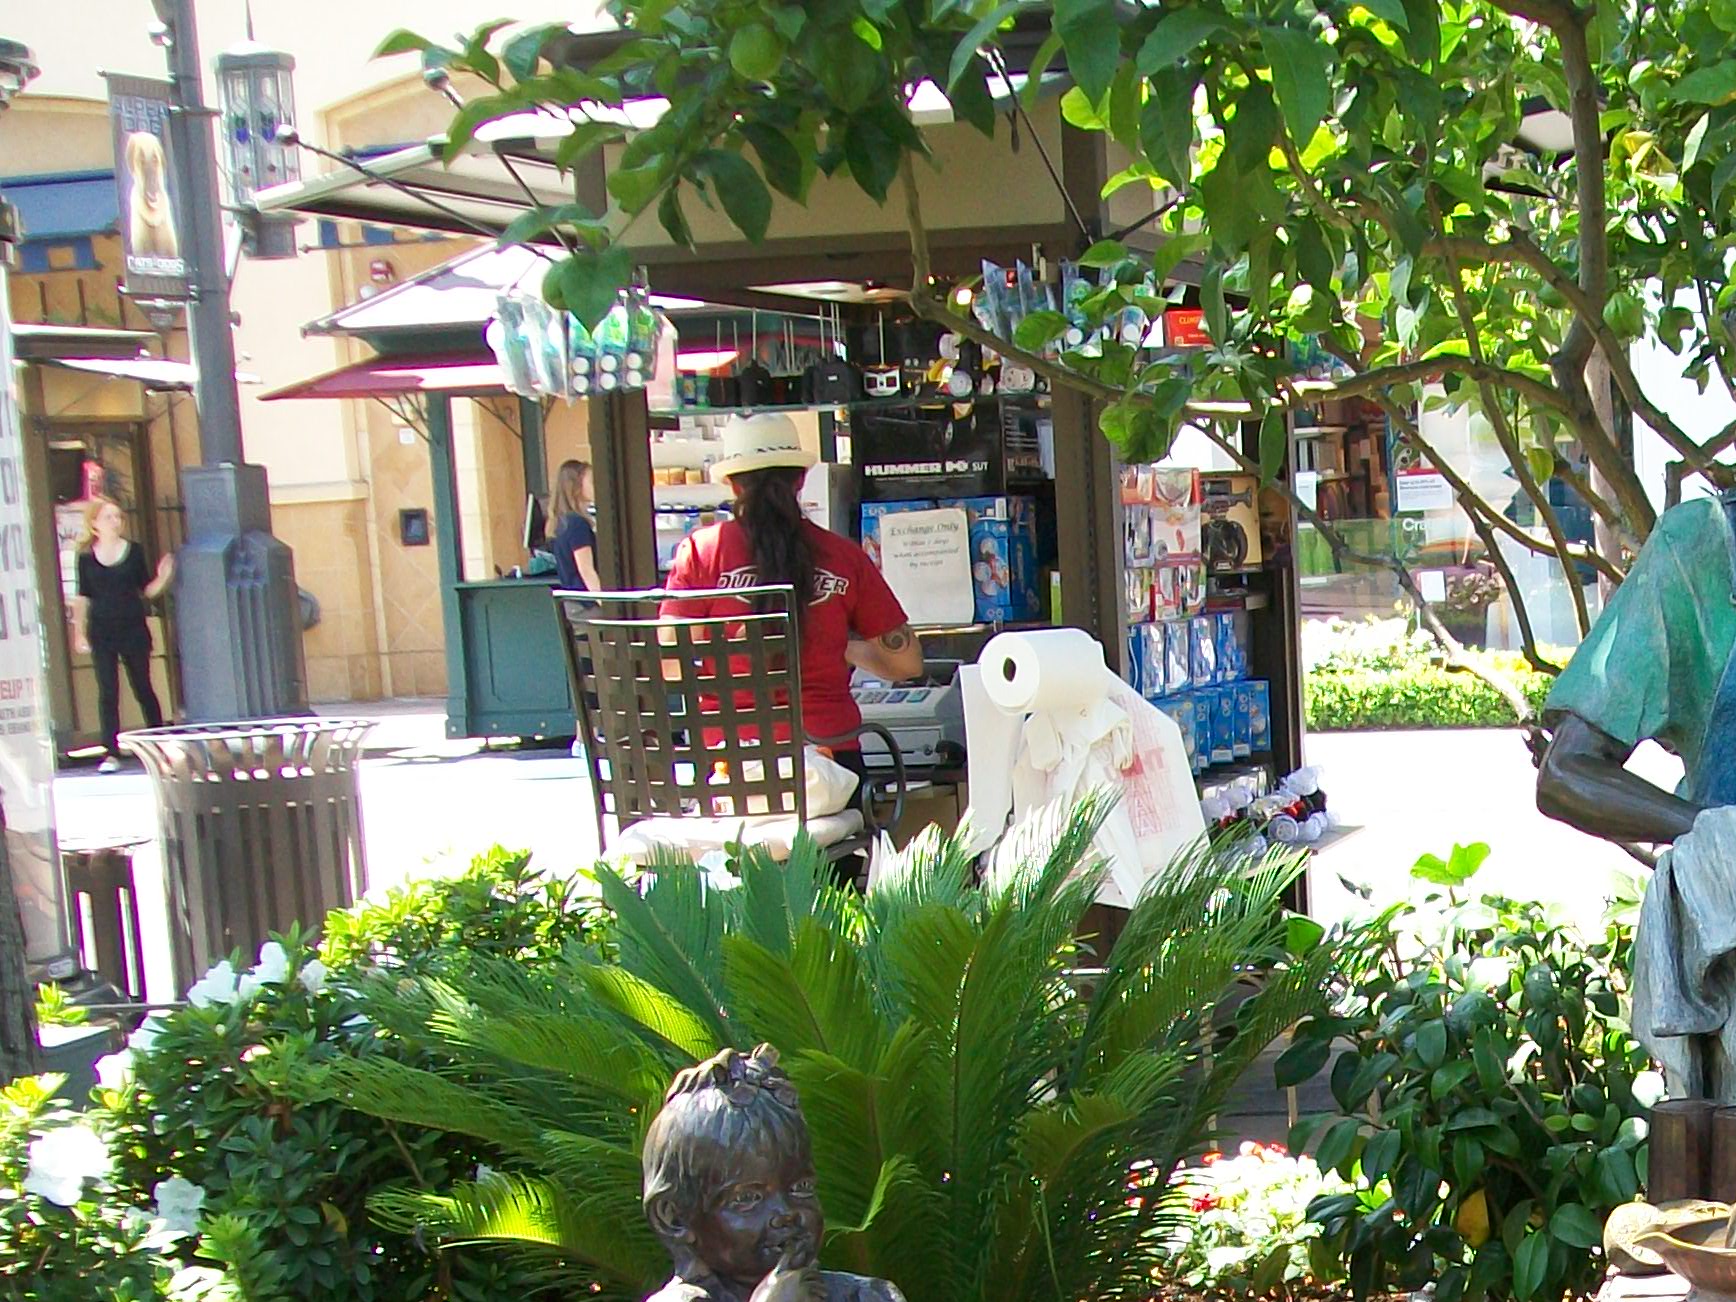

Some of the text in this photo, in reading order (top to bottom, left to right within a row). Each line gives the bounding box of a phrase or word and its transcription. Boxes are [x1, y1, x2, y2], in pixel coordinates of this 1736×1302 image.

[864, 461, 943, 477] HUMMER
[891, 522, 959, 537] Exchange Only
